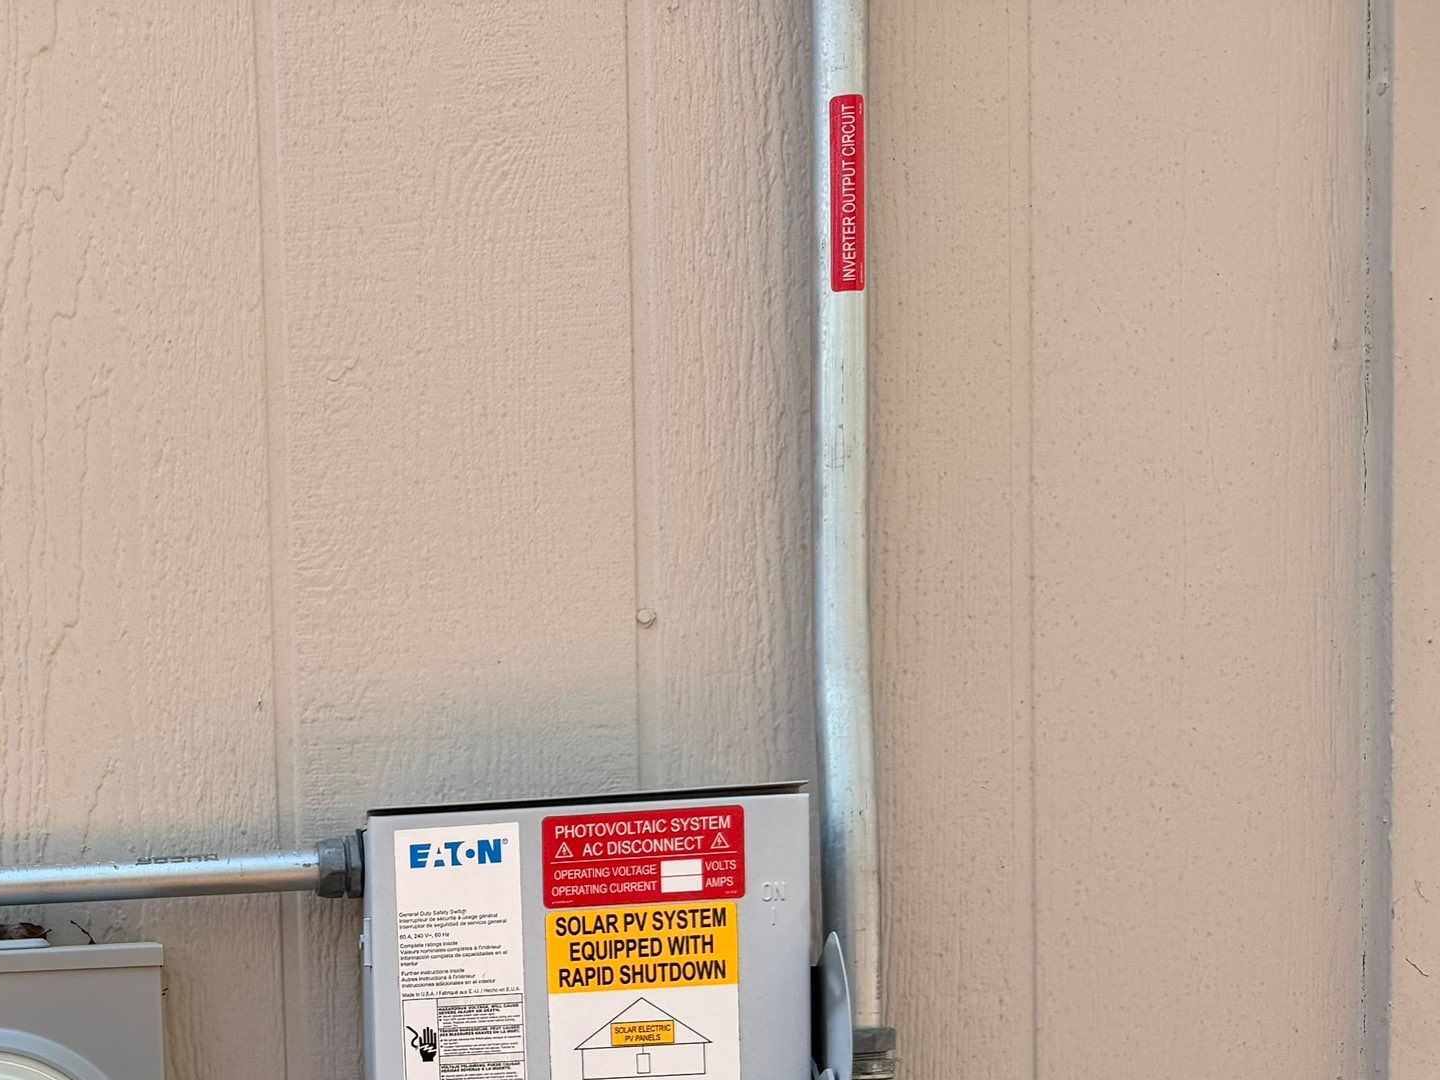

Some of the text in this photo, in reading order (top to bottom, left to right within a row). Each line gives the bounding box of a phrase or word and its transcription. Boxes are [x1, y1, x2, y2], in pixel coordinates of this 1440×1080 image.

[842, 104, 856, 281] INVERTER OUTPUT CIRCUIT
[555, 815, 730, 839] PHOTOVOLTAIC SYSTEM
[410, 839, 502, 868] EATON
[582, 836, 703, 857] AC DISCONNECT
[554, 860, 736, 880] OPERATING VOLTAGE VOLTS
[552, 877, 733, 896] OPERATING CURRENT AMPS
[762, 882, 785, 902] ON
[556, 908, 726, 936] SOLAR PV SYSTEM
[570, 935, 714, 961] EQUIPPED WITH
[559, 961, 726, 987] RAPID SHUTDOWN
[615, 1024, 670, 1033] SOLAR ELECTRIC
